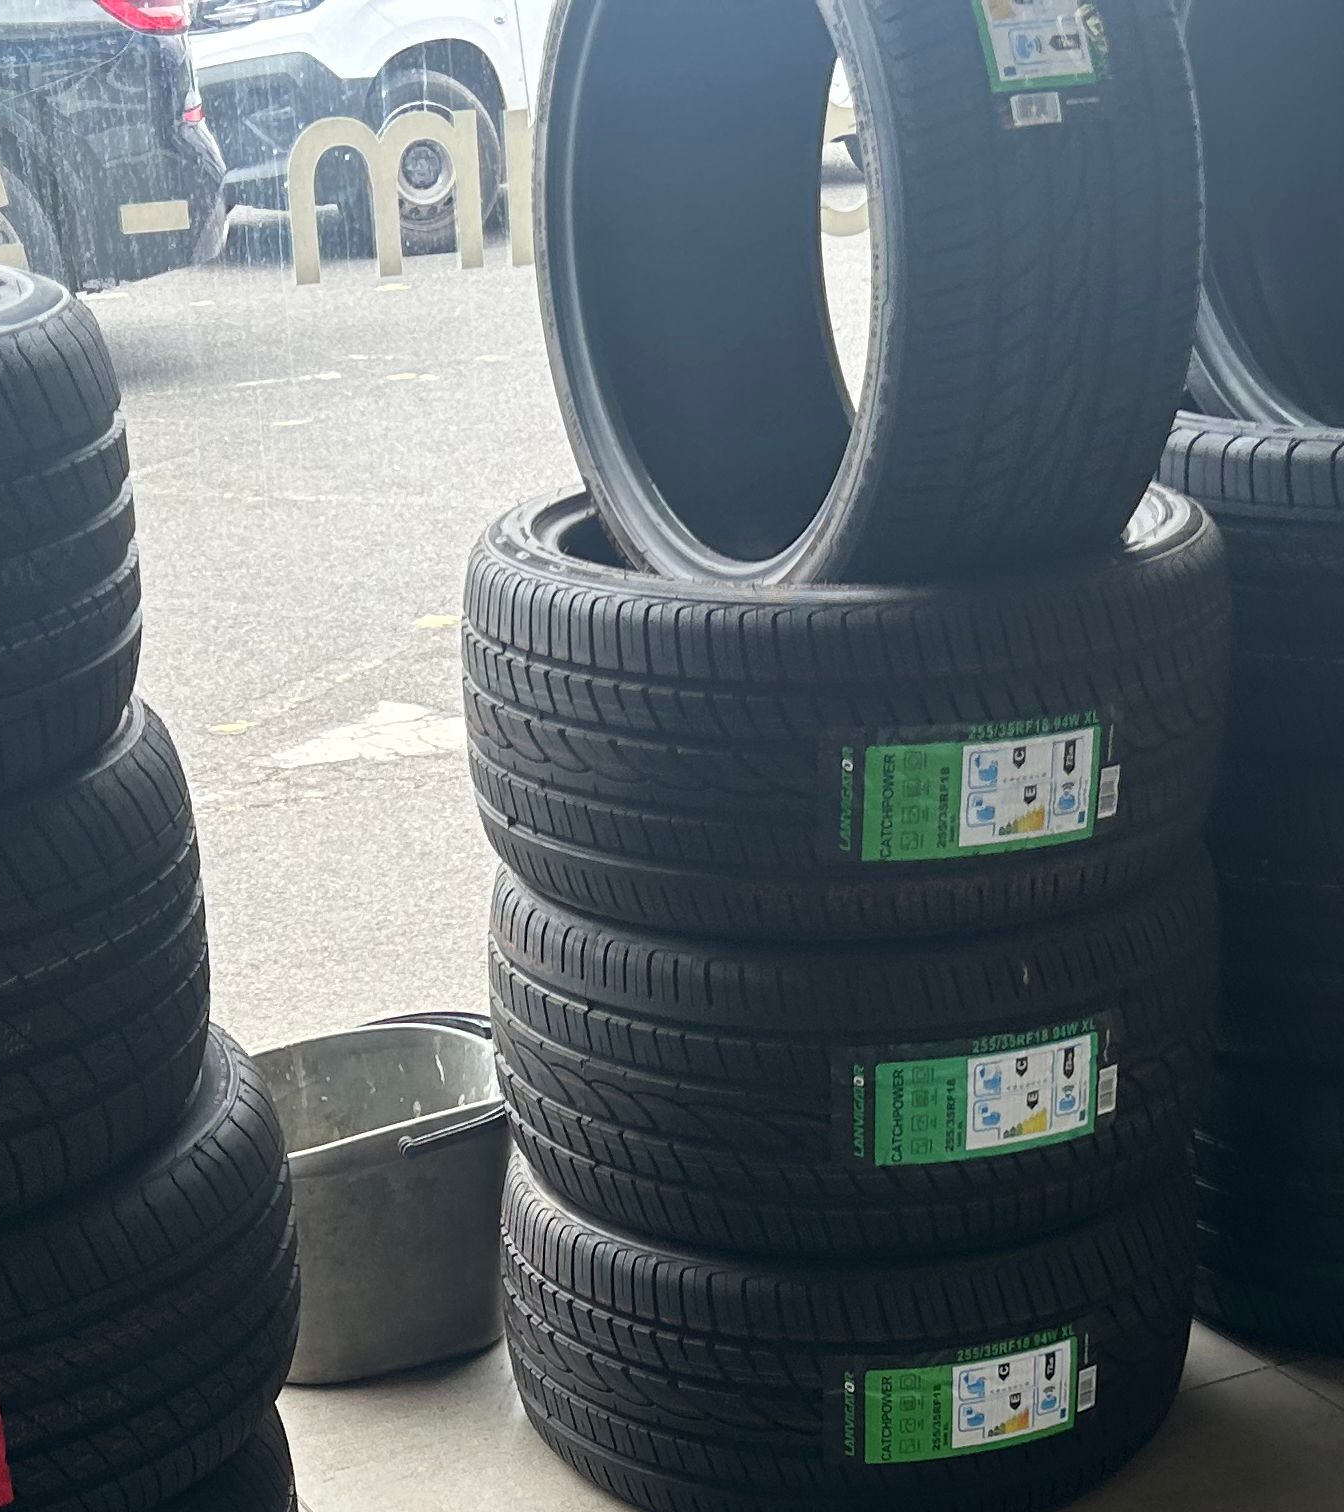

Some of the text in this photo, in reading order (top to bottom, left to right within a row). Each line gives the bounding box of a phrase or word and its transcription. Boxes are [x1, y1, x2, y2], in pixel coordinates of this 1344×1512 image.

[880, 753, 896, 858] CATCHPOWER
[891, 1069, 904, 1163] CATCHPOWER
[881, 1375, 893, 1461] CATCHPOWER
